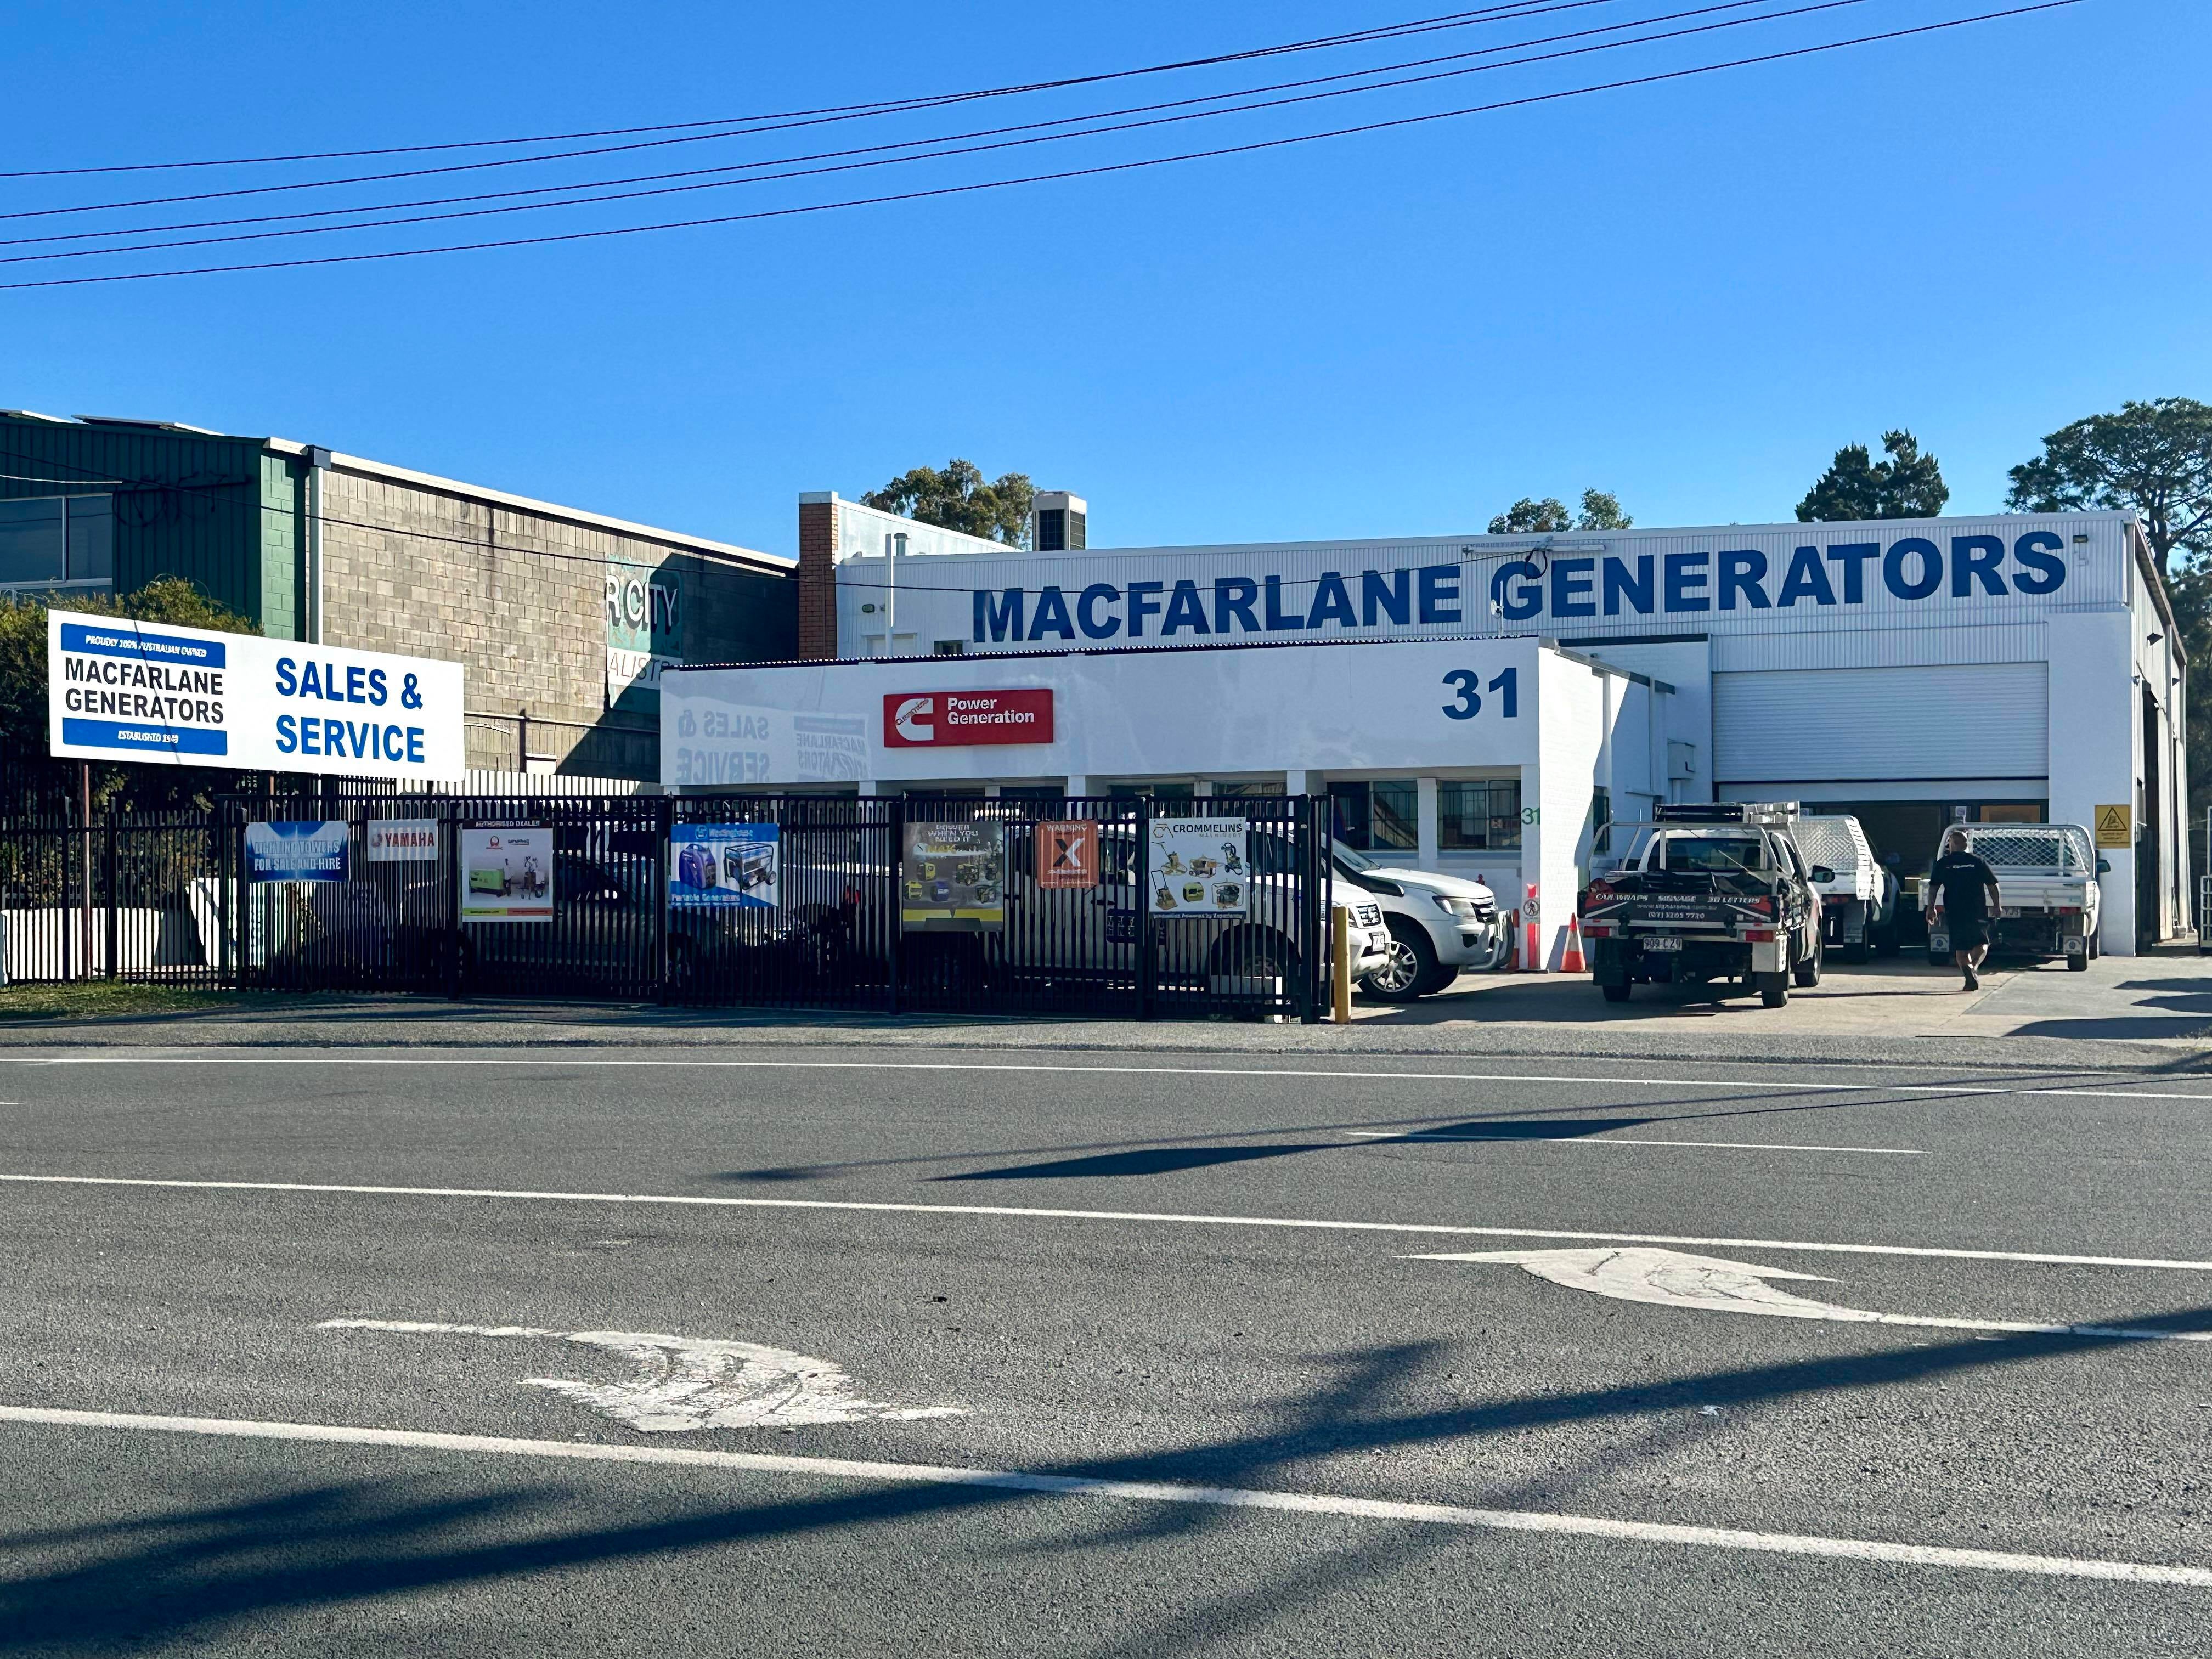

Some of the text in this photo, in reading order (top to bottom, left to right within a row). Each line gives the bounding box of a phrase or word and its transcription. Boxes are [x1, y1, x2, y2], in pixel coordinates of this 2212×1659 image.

[973, 531, 2066, 643] MACFARLANE GENERATORS
[627, 579, 678, 627] CITY
[86, 635, 119, 647] PROUDLY
[119, 639, 137, 650] 100%
[138, 641, 180, 654] AUSTRALIAN
[65, 657, 223, 696] MACFARLANE
[276, 657, 424, 709] SALES &
[1441, 667, 1518, 720] 31
[65, 688, 224, 724] GENERATORS
[947, 697, 997, 710] Power
[947, 710, 1035, 725] Generation
[118, 730, 161, 742] ESTABLISHED
[276, 714, 425, 763] SERVICE
[1521, 808, 1541, 825] 31
[1173, 823, 1243, 833] CROMMELINS
[385, 832, 435, 848] YAMAHA
[254, 857, 341, 871] FOR SALE AND HIRE
